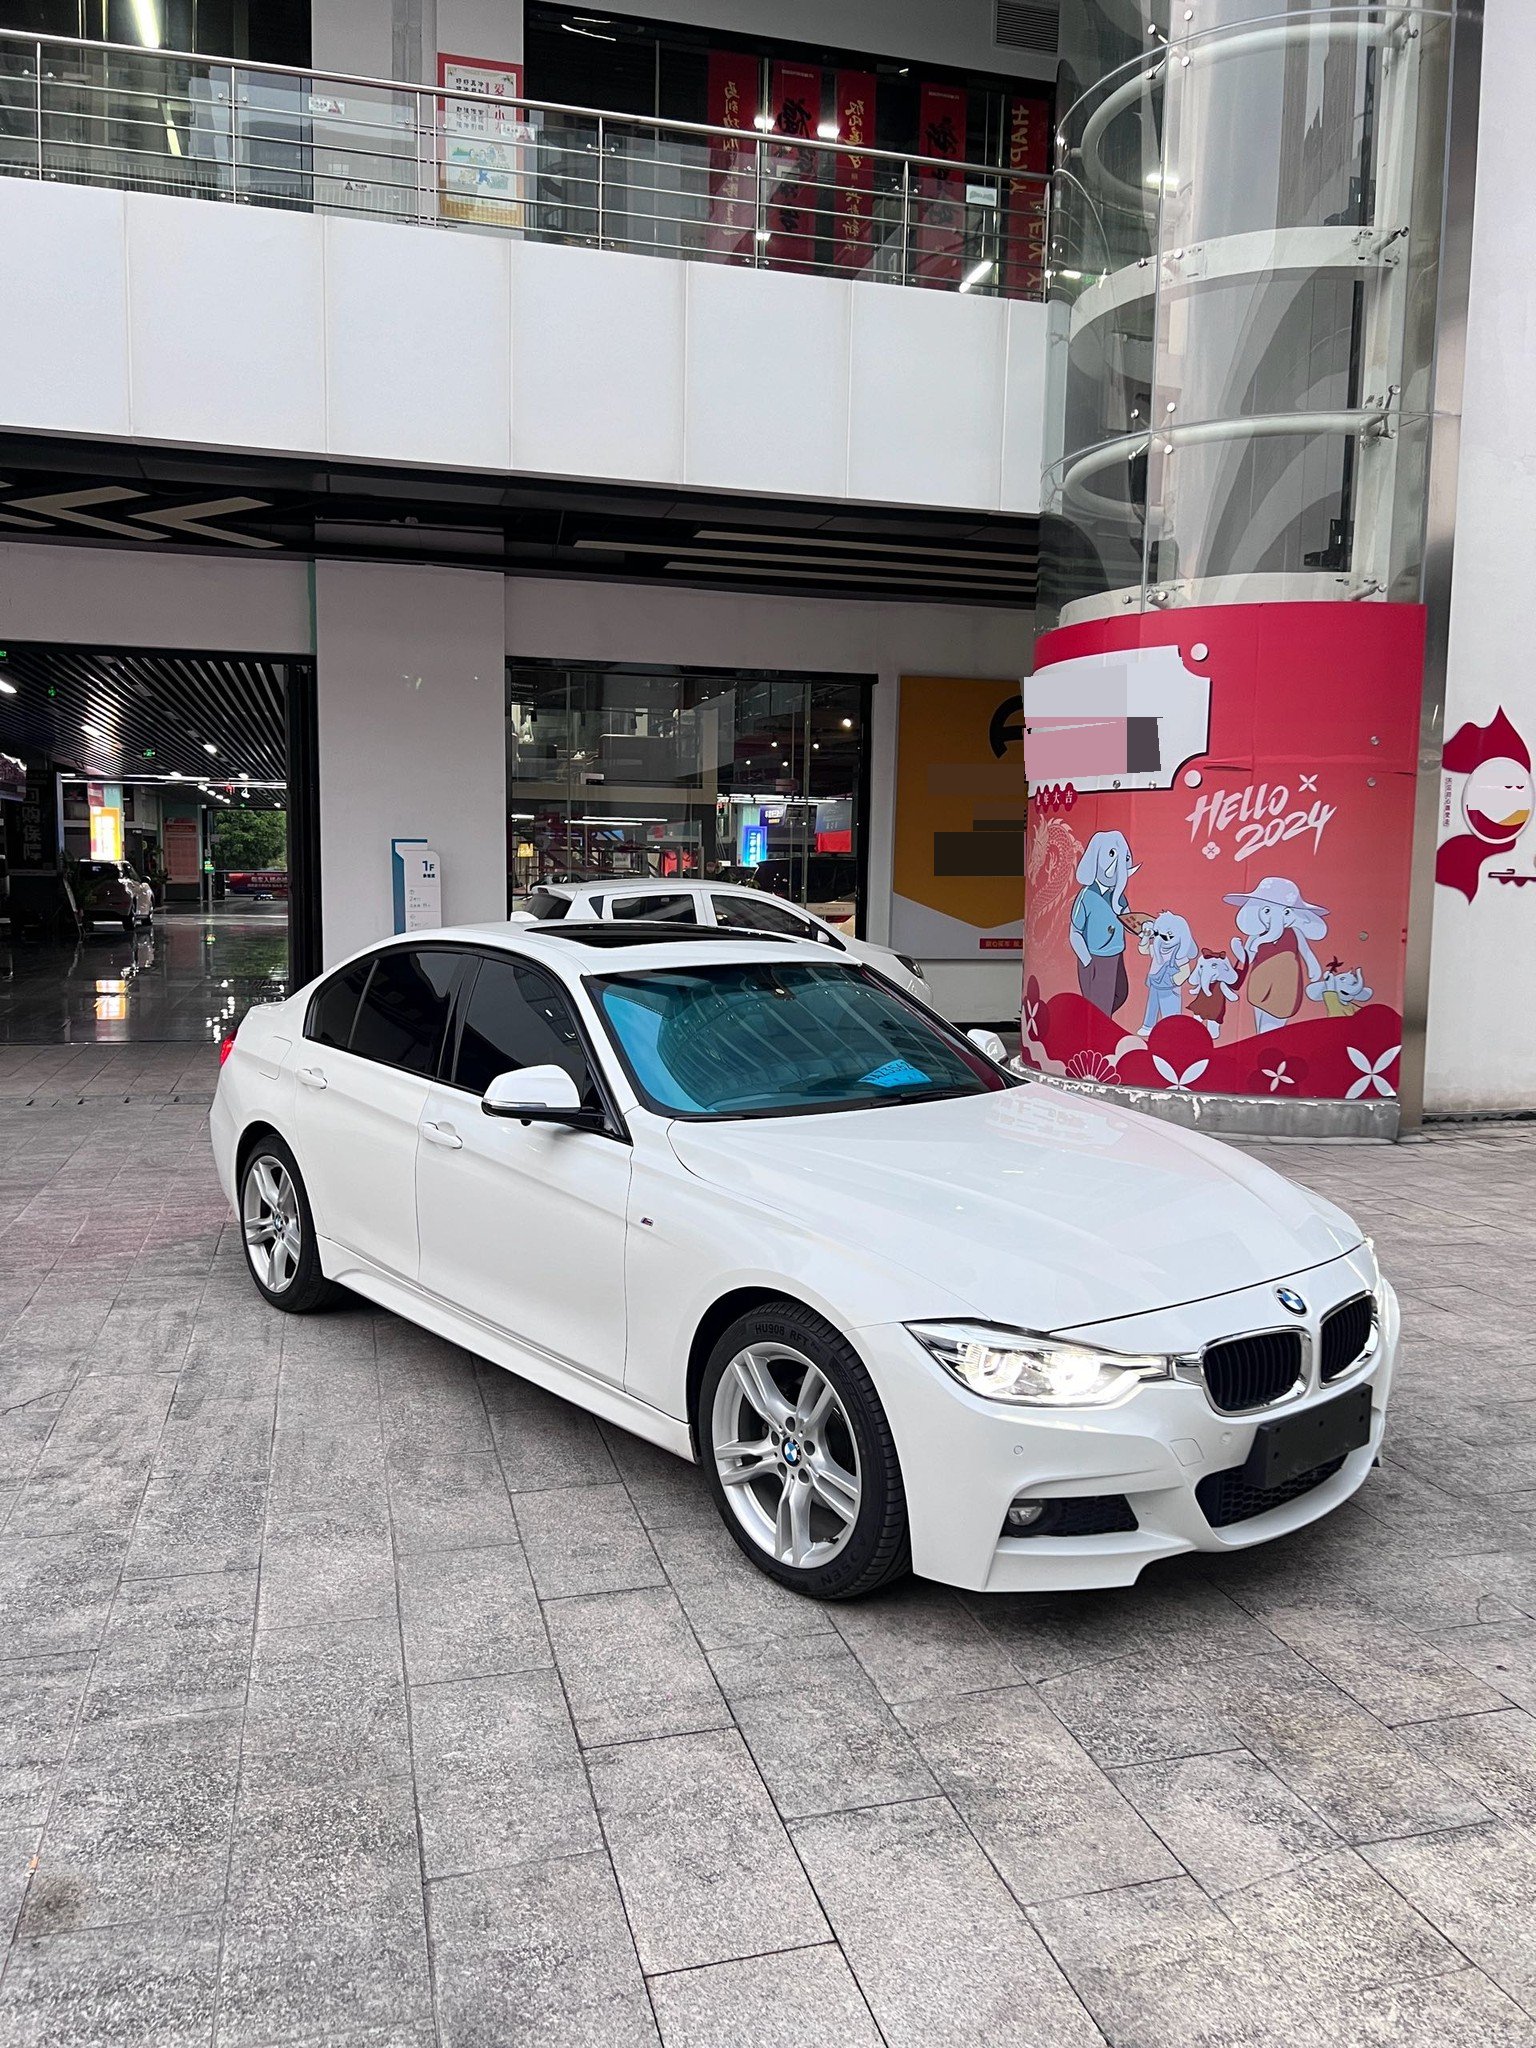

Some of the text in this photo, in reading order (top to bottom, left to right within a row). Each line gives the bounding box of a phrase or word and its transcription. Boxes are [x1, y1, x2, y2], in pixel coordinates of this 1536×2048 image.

[1185, 783, 1289, 843] HELLO
[1234, 800, 1337, 862] 2024
[421, 860, 435, 872] 1F
